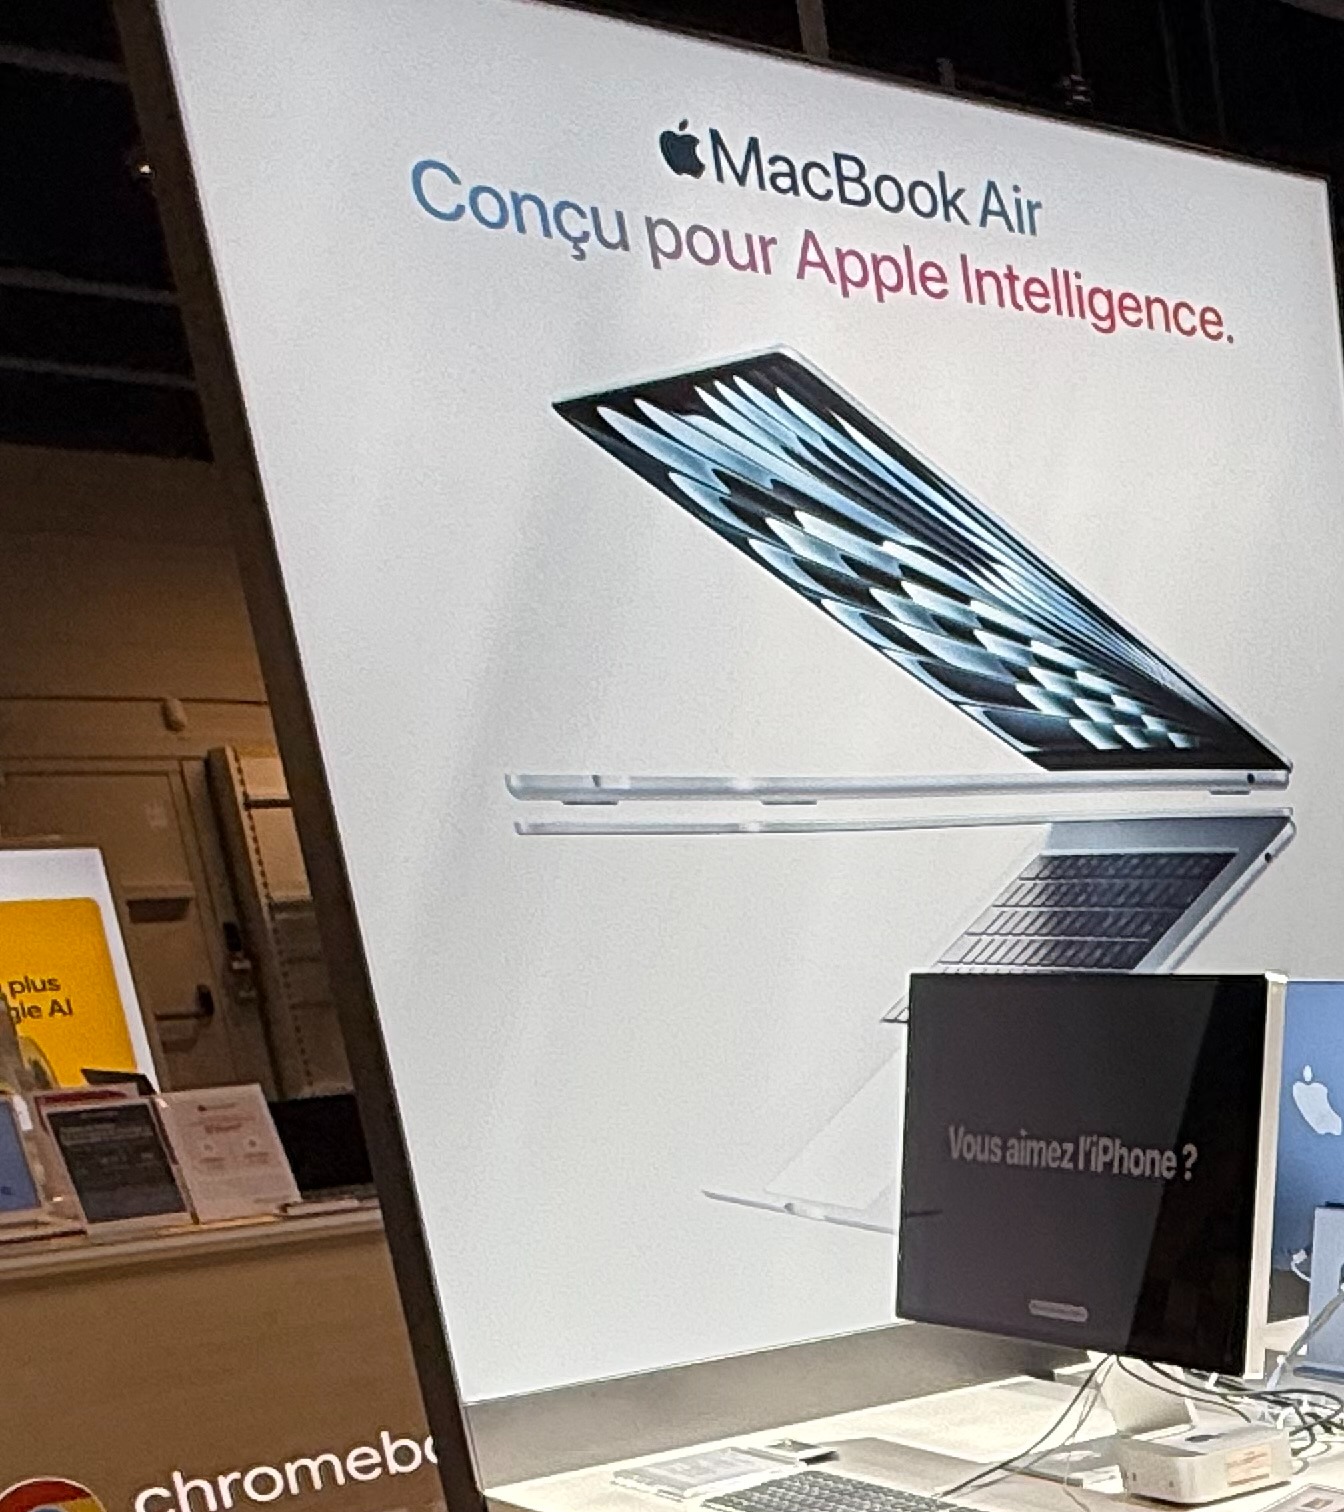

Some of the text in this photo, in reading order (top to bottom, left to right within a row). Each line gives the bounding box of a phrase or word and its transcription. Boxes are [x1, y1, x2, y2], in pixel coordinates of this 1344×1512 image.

[708, 128, 1043, 236] MacBook Air
[411, 158, 1235, 344] Conçu pour Apple Intelligence.
[7, 975, 61, 999] plus
[7, 999, 42, 1024] gle
[948, 1125, 1001, 1164] Vous
[1007, 1129, 1074, 1169] aimez
[1183, 1143, 1198, 1180] ?
